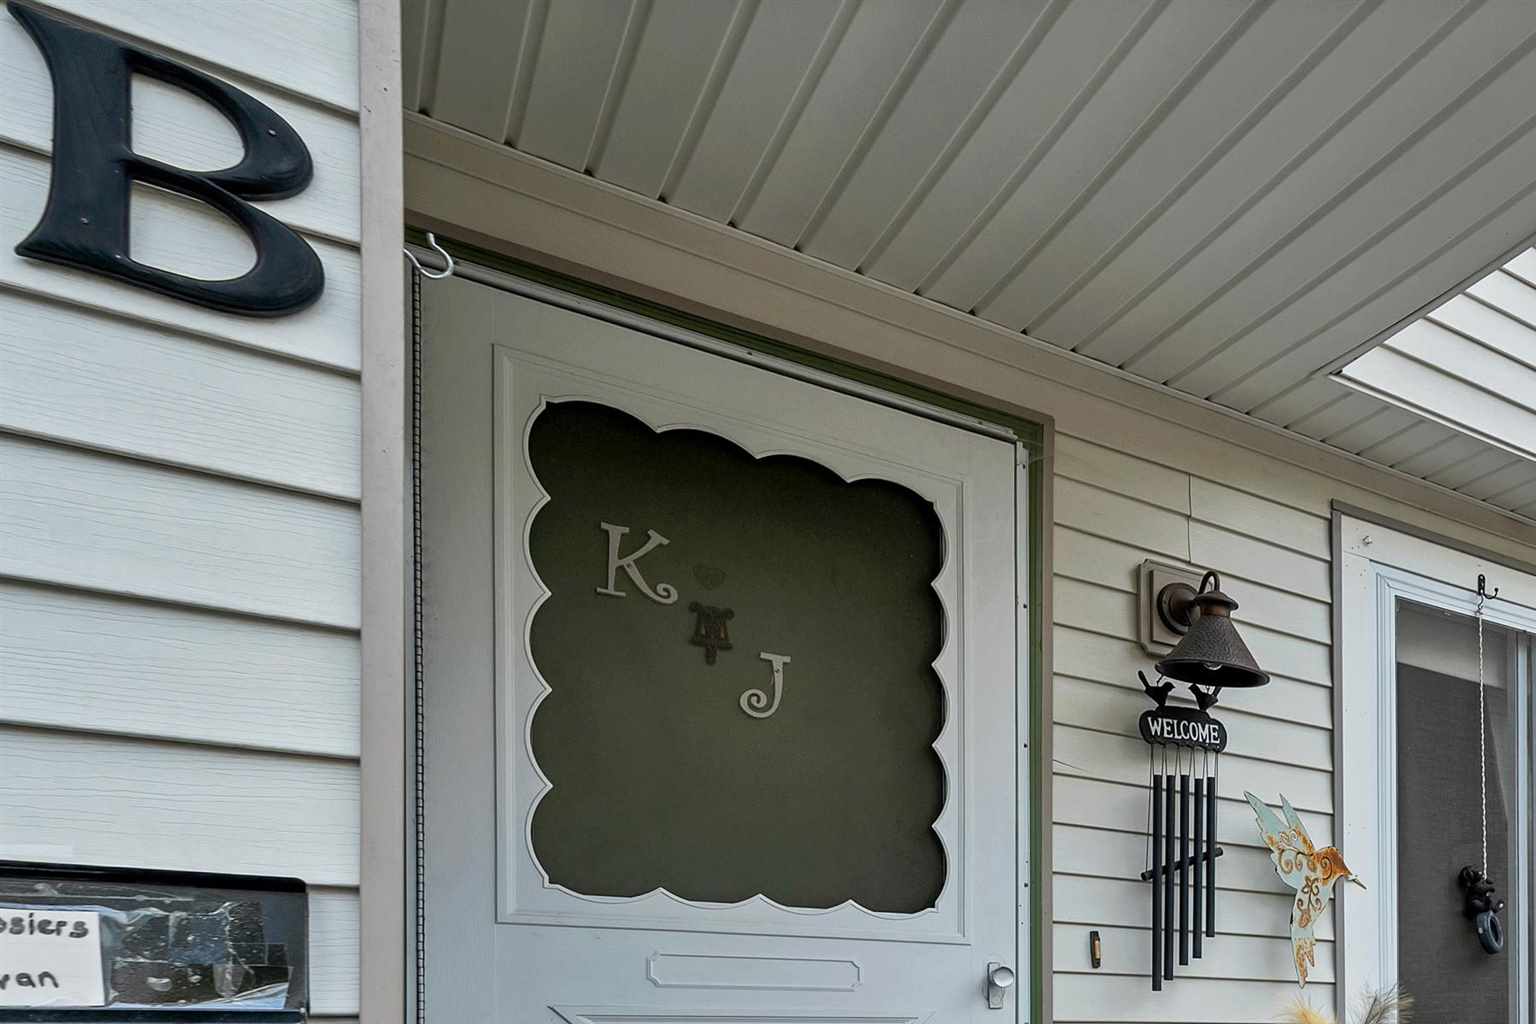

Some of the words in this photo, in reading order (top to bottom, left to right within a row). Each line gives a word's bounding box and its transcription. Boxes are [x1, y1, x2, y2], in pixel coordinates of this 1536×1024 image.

[6, 0, 326, 319] B
[596, 521, 679, 604] K
[739, 651, 792, 719] J
[1147, 716, 1221, 744] WELCOME
